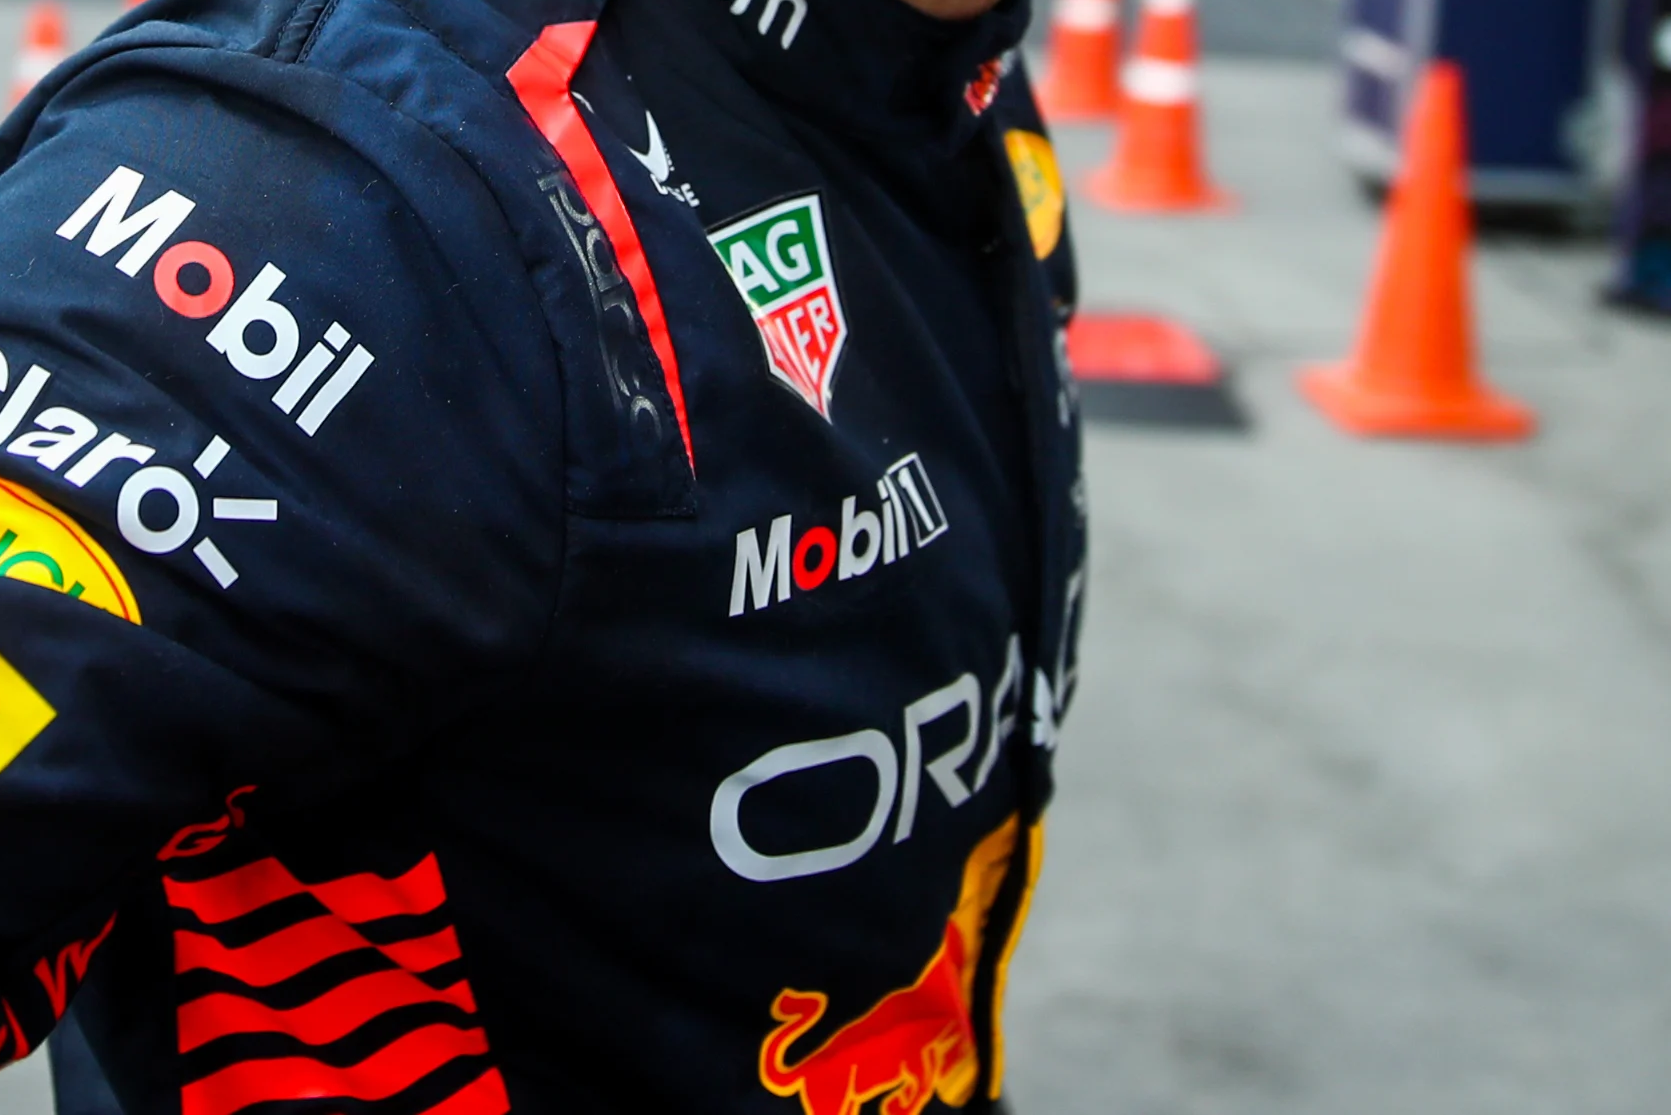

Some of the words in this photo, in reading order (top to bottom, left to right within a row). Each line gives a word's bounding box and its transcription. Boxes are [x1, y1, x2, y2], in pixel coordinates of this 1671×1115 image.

[56, 165, 375, 437] Mobil
[729, 219, 813, 294] AG
[729, 474, 910, 617] Mobil
